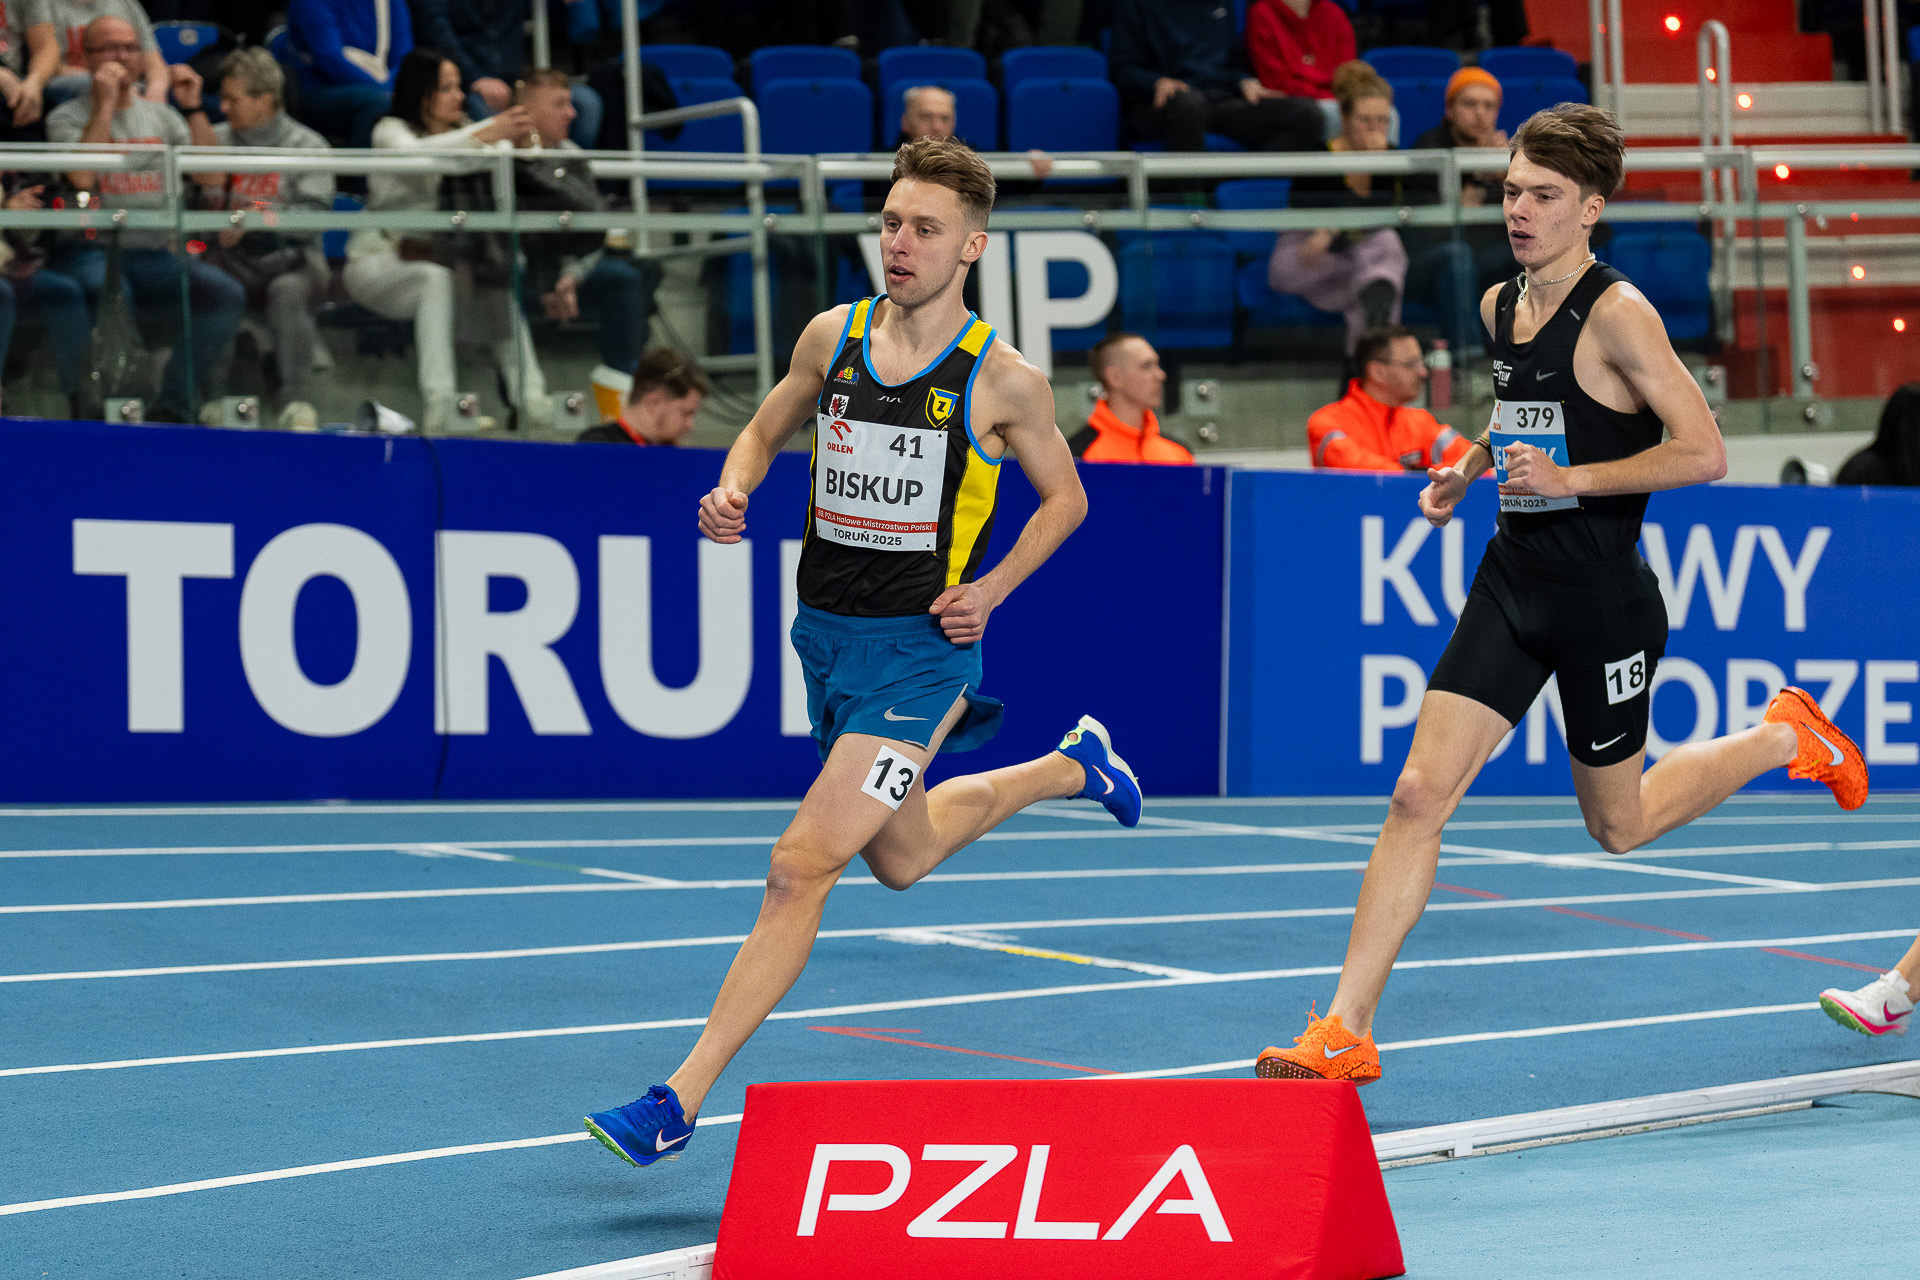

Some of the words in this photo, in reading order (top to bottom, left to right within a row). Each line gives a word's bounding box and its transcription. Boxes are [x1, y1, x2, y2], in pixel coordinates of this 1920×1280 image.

[1516, 407, 1555, 429] 379
[826, 442, 854, 455] ORLEN
[889, 433, 924, 459] 41
[826, 467, 924, 506] BISKUP
[1500, 496, 1522, 508] ORUŃ
[1523, 498, 1548, 508] 2025
[833, 527, 870, 543] TORUŃ
[872, 534, 902, 546] 2025
[836, 515, 862, 526] Halowe
[862, 519, 910, 531] Mistrzostwa
[910, 523, 933, 531] Polski
[1361, 515, 1832, 633] KUWY
[1608, 660, 1644, 696] 18
[1360, 654, 1918, 766] PORZE
[873, 757, 914, 802] 13
[796, 1143, 1234, 1243] PZLA
